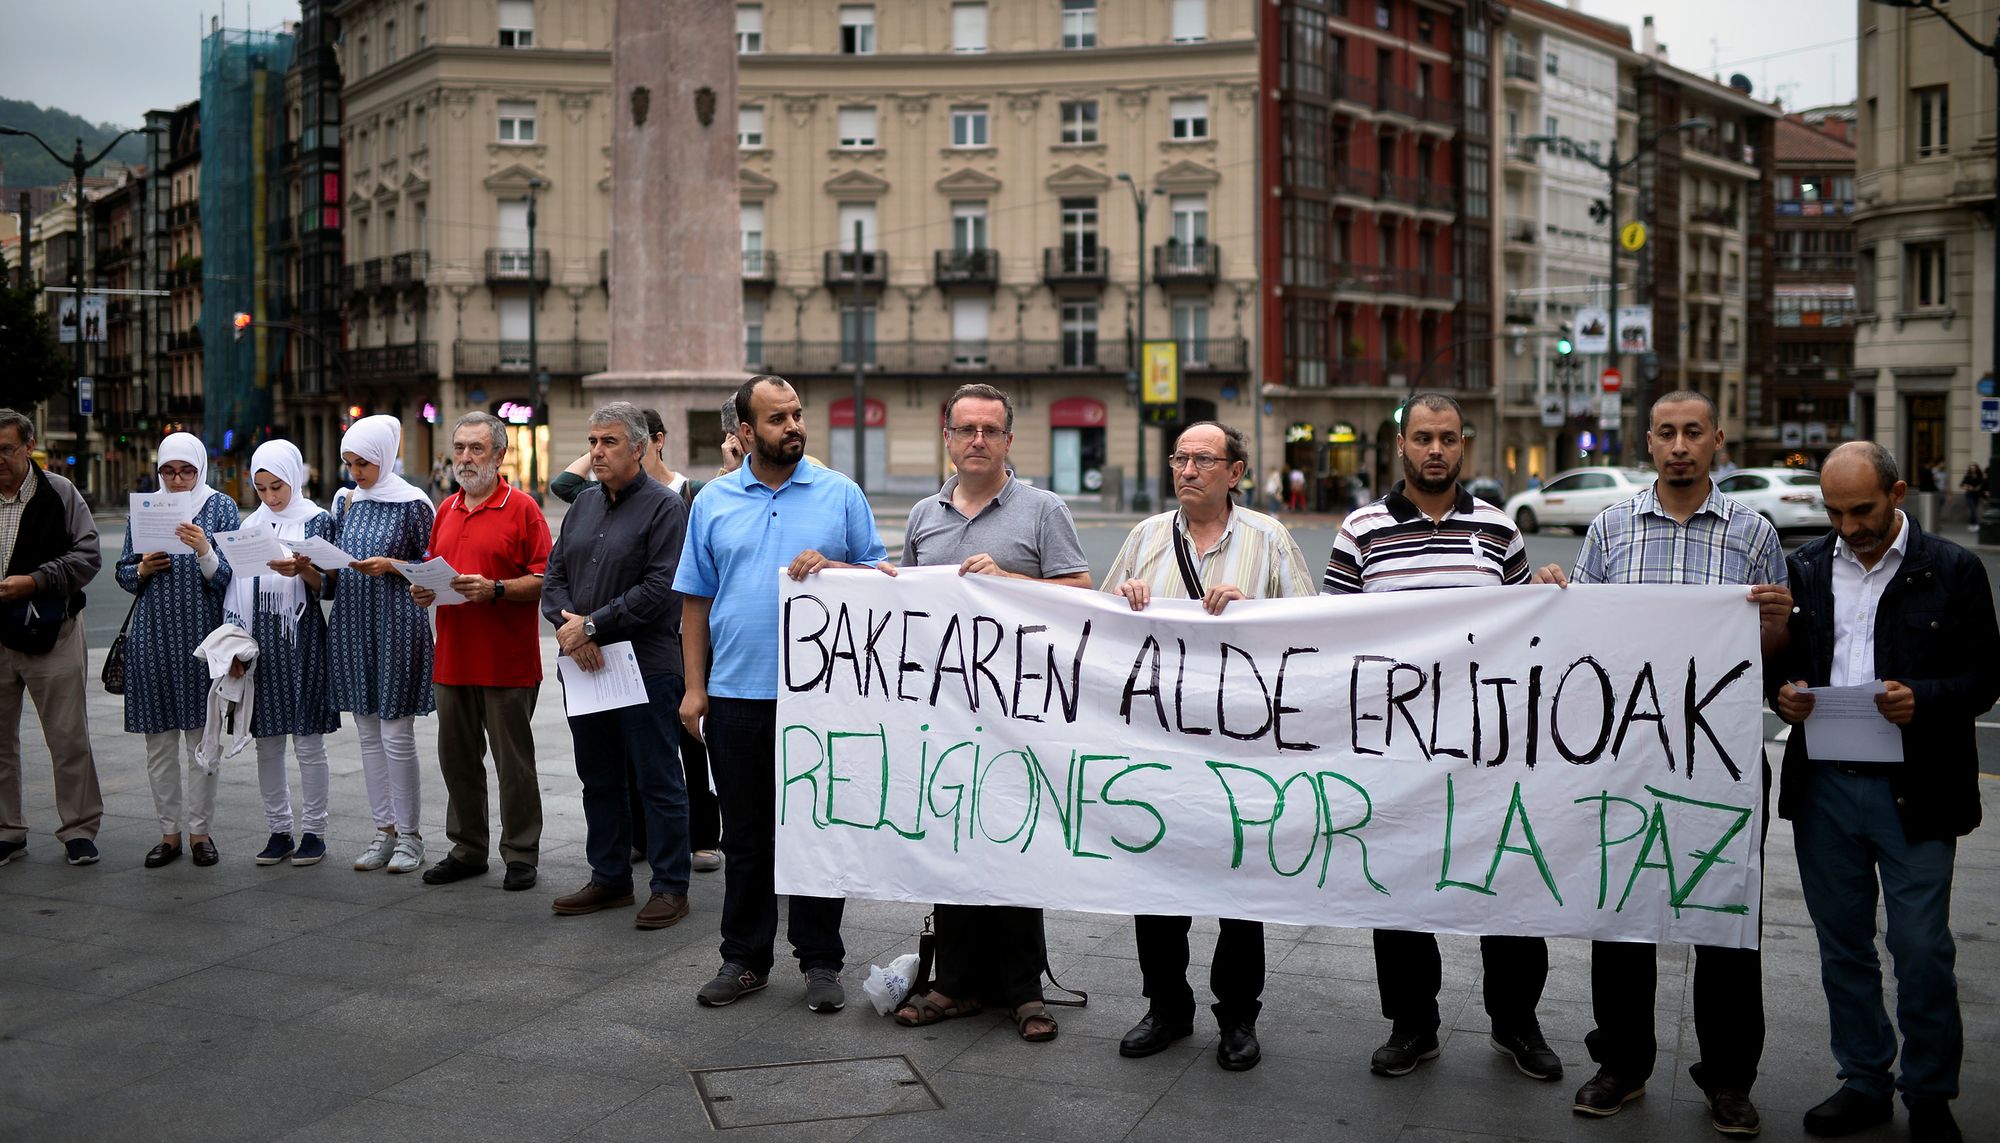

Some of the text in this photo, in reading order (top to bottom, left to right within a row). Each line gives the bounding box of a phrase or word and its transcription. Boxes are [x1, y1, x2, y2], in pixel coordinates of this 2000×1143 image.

[784, 594, 1092, 724] BAKEAREN
[1119, 634, 1320, 752] ALDE
[1204, 761, 1391, 896] POR
[1434, 772, 1564, 907] LA
[1573, 784, 1753, 919] PAZ
